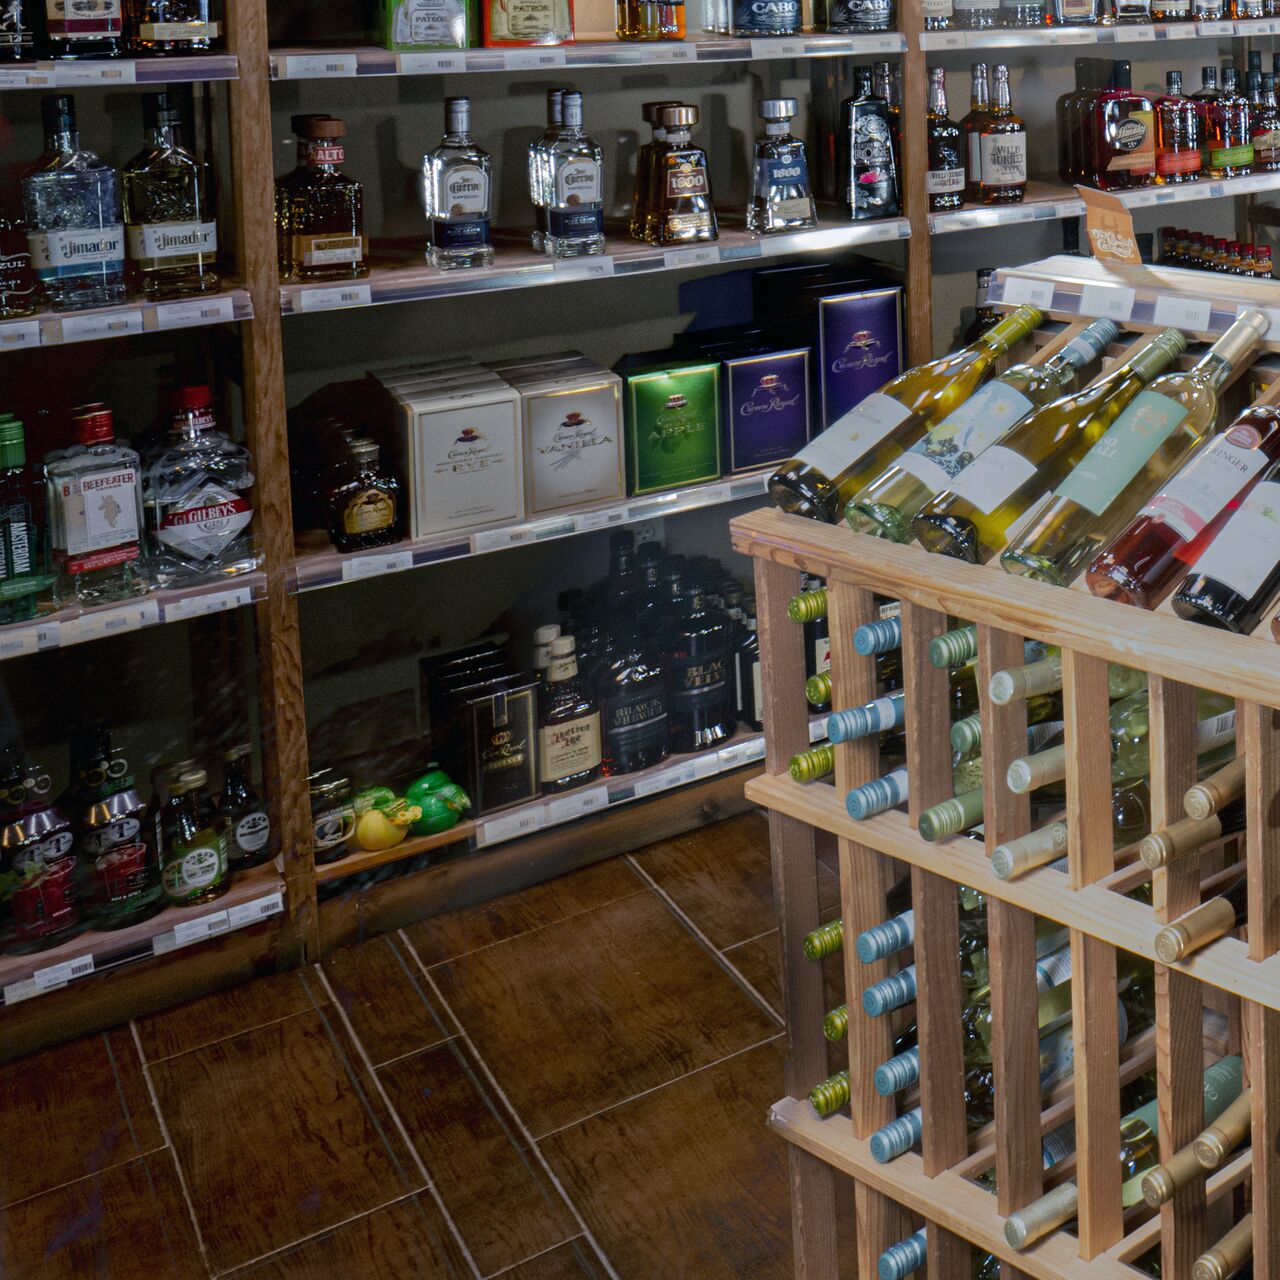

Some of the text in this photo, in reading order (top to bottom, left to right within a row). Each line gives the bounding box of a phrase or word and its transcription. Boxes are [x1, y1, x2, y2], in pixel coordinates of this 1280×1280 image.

[752, 1, 798, 13] CABO
[855, 148, 890, 160] ROSE
[672, 176, 704, 189] 1800
[64, 239, 119, 258] Jimador
[648, 422, 706, 441] APPLE
[83, 472, 135, 493] BEEFEATER
[188, 503, 237, 525] GILBEY'S
[10, 520, 30, 573] AMSTERDAM
[687, 658, 723, 677] BLAC
